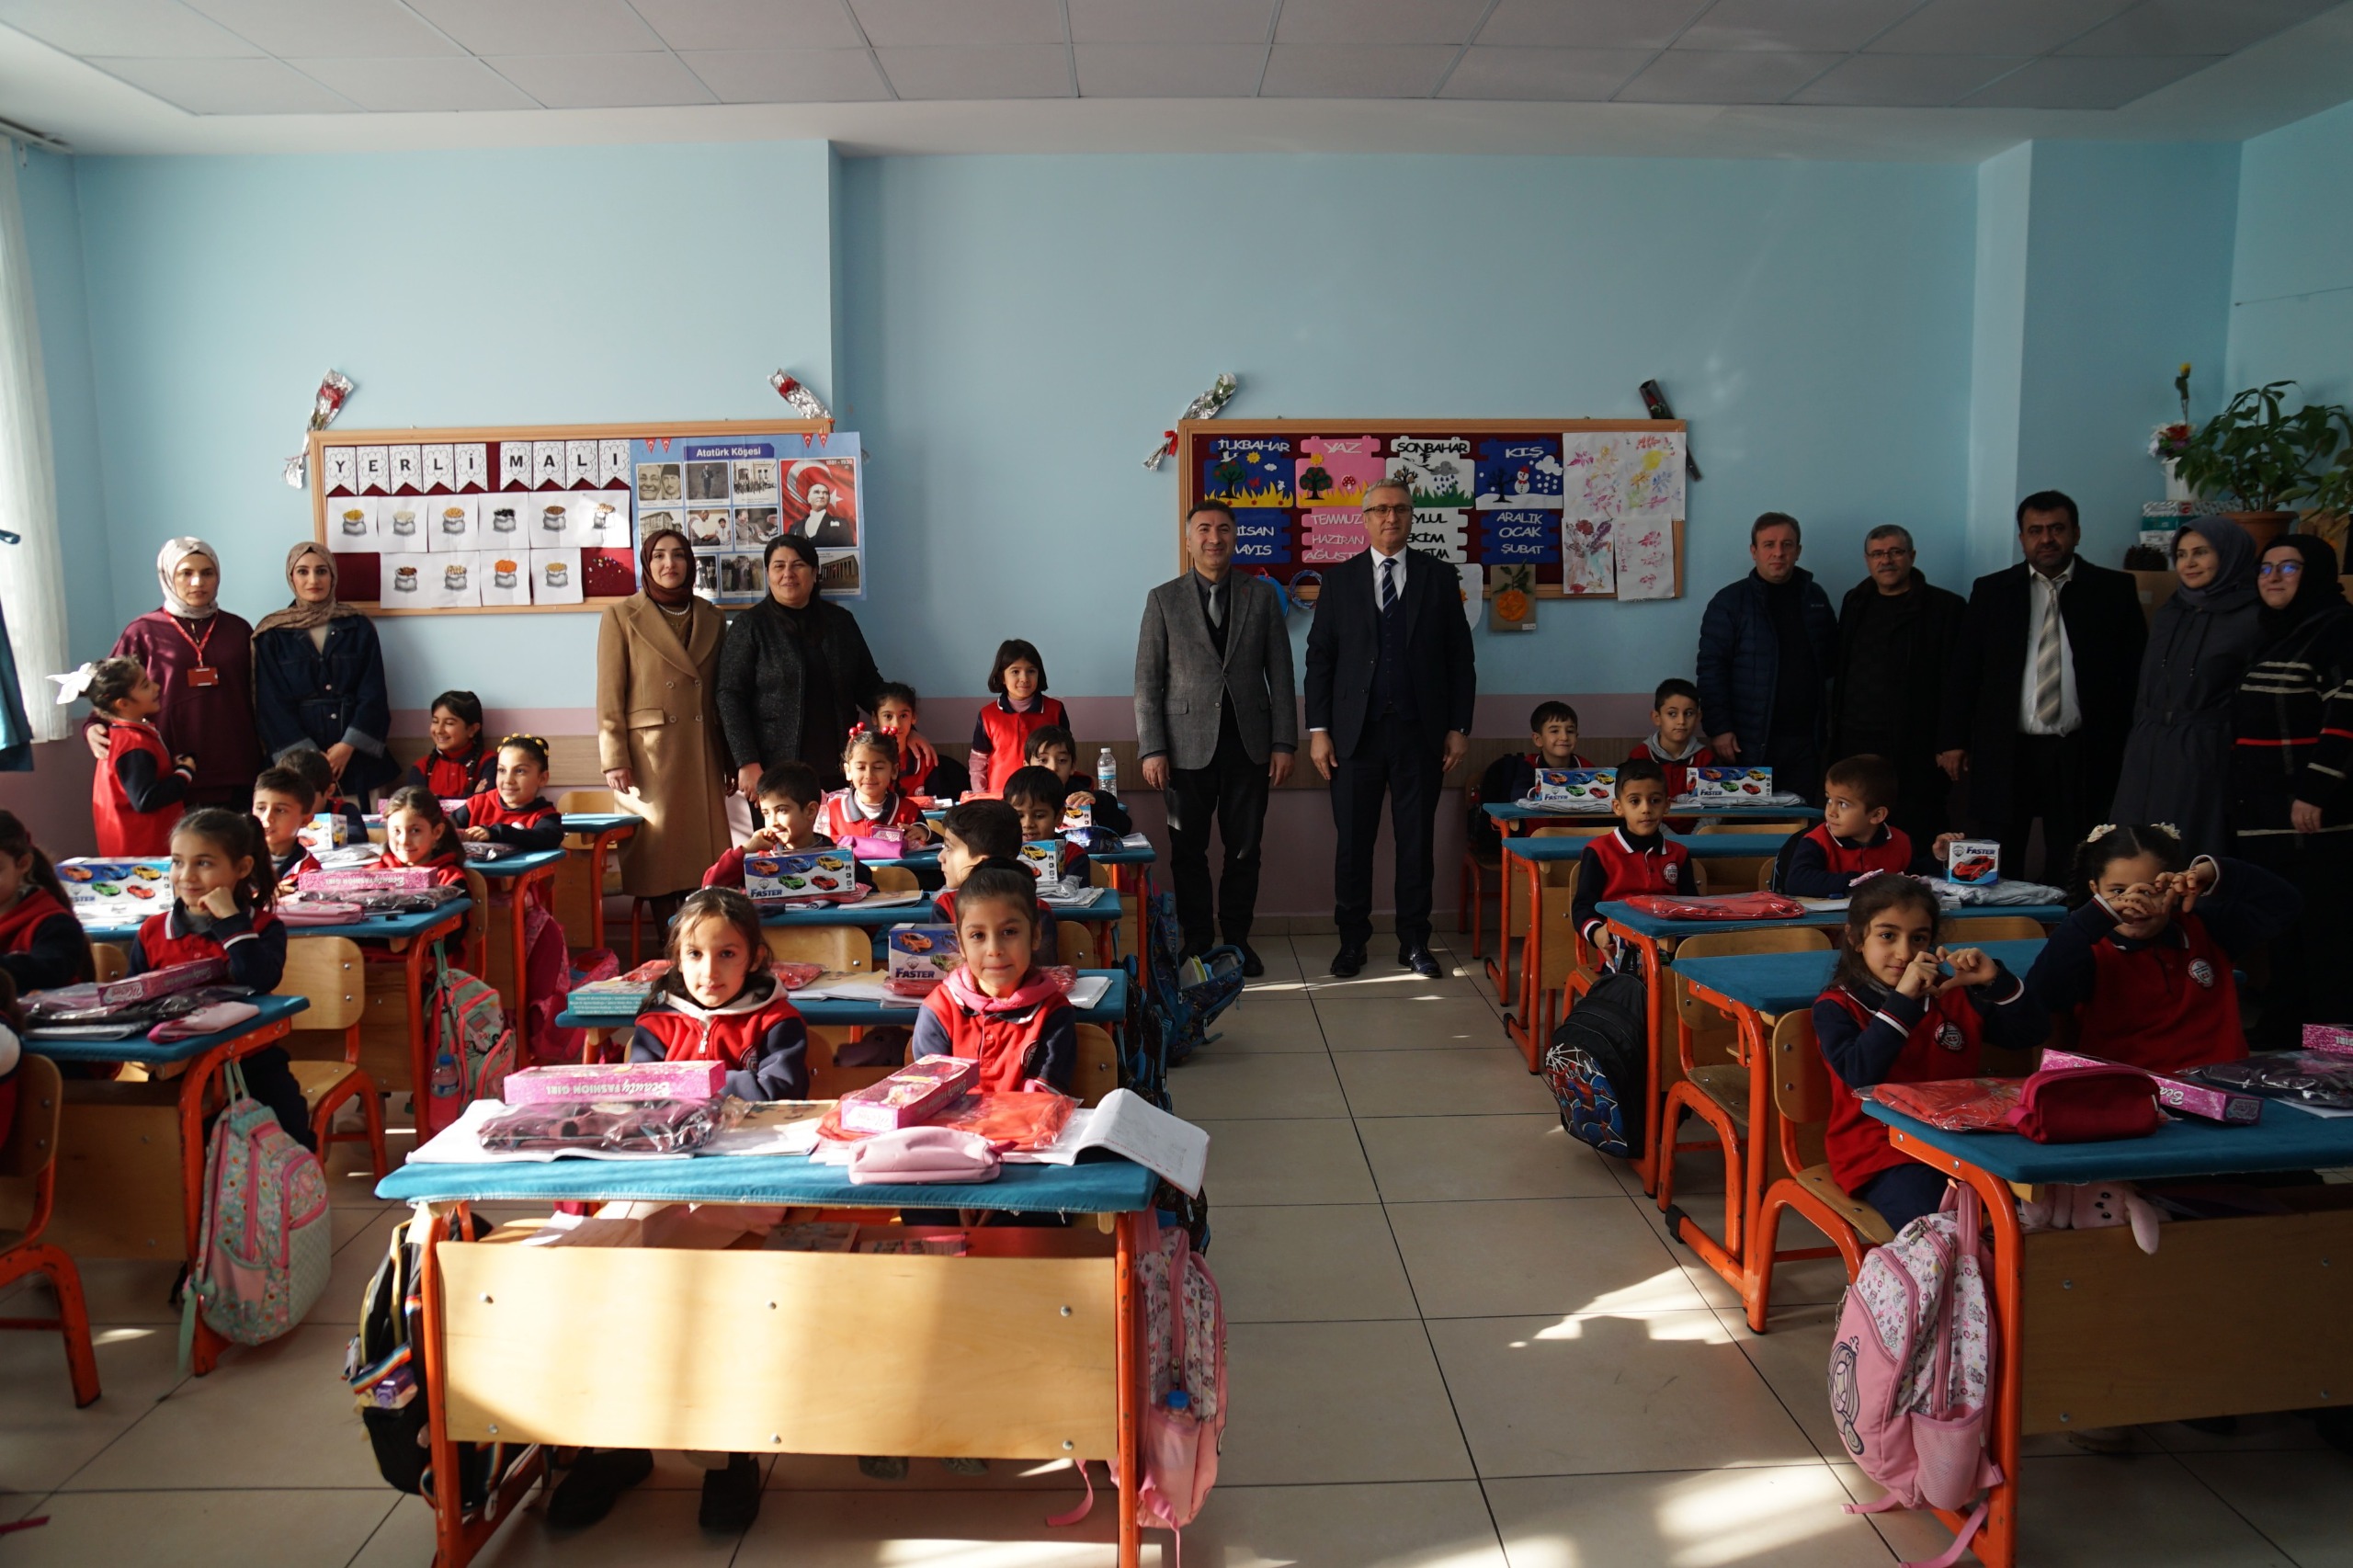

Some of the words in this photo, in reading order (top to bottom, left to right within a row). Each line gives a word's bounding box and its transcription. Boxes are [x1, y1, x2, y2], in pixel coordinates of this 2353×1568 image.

[696, 447, 730, 458] Atatürk
[731, 446, 762, 458] Köşesi
[1323, 442, 1362, 454] YAZ
[1396, 442, 1468, 454] SONBAHAR
[1505, 446, 1544, 459] KIŞ
[335, 453, 473, 473] YERLİ
[509, 452, 619, 469] MALI
[1310, 513, 1363, 525] TEMMUZ
[1496, 512, 1543, 525] ARALIK
[1498, 526, 1542, 538] OCAK
[1501, 543, 1544, 554] ŞUBAT
[1304, 548, 1360, 562] AĞUST
[1966, 846, 1995, 855] FASTER
[751, 889, 783, 897] FASTER
[895, 967, 936, 978] FASTER
[546, 1086, 570, 1095] GIRL
[573, 1085, 621, 1094] FASHION
[621, 1079, 672, 1096] Beauty
[2160, 1085, 2185, 1106] Bea
